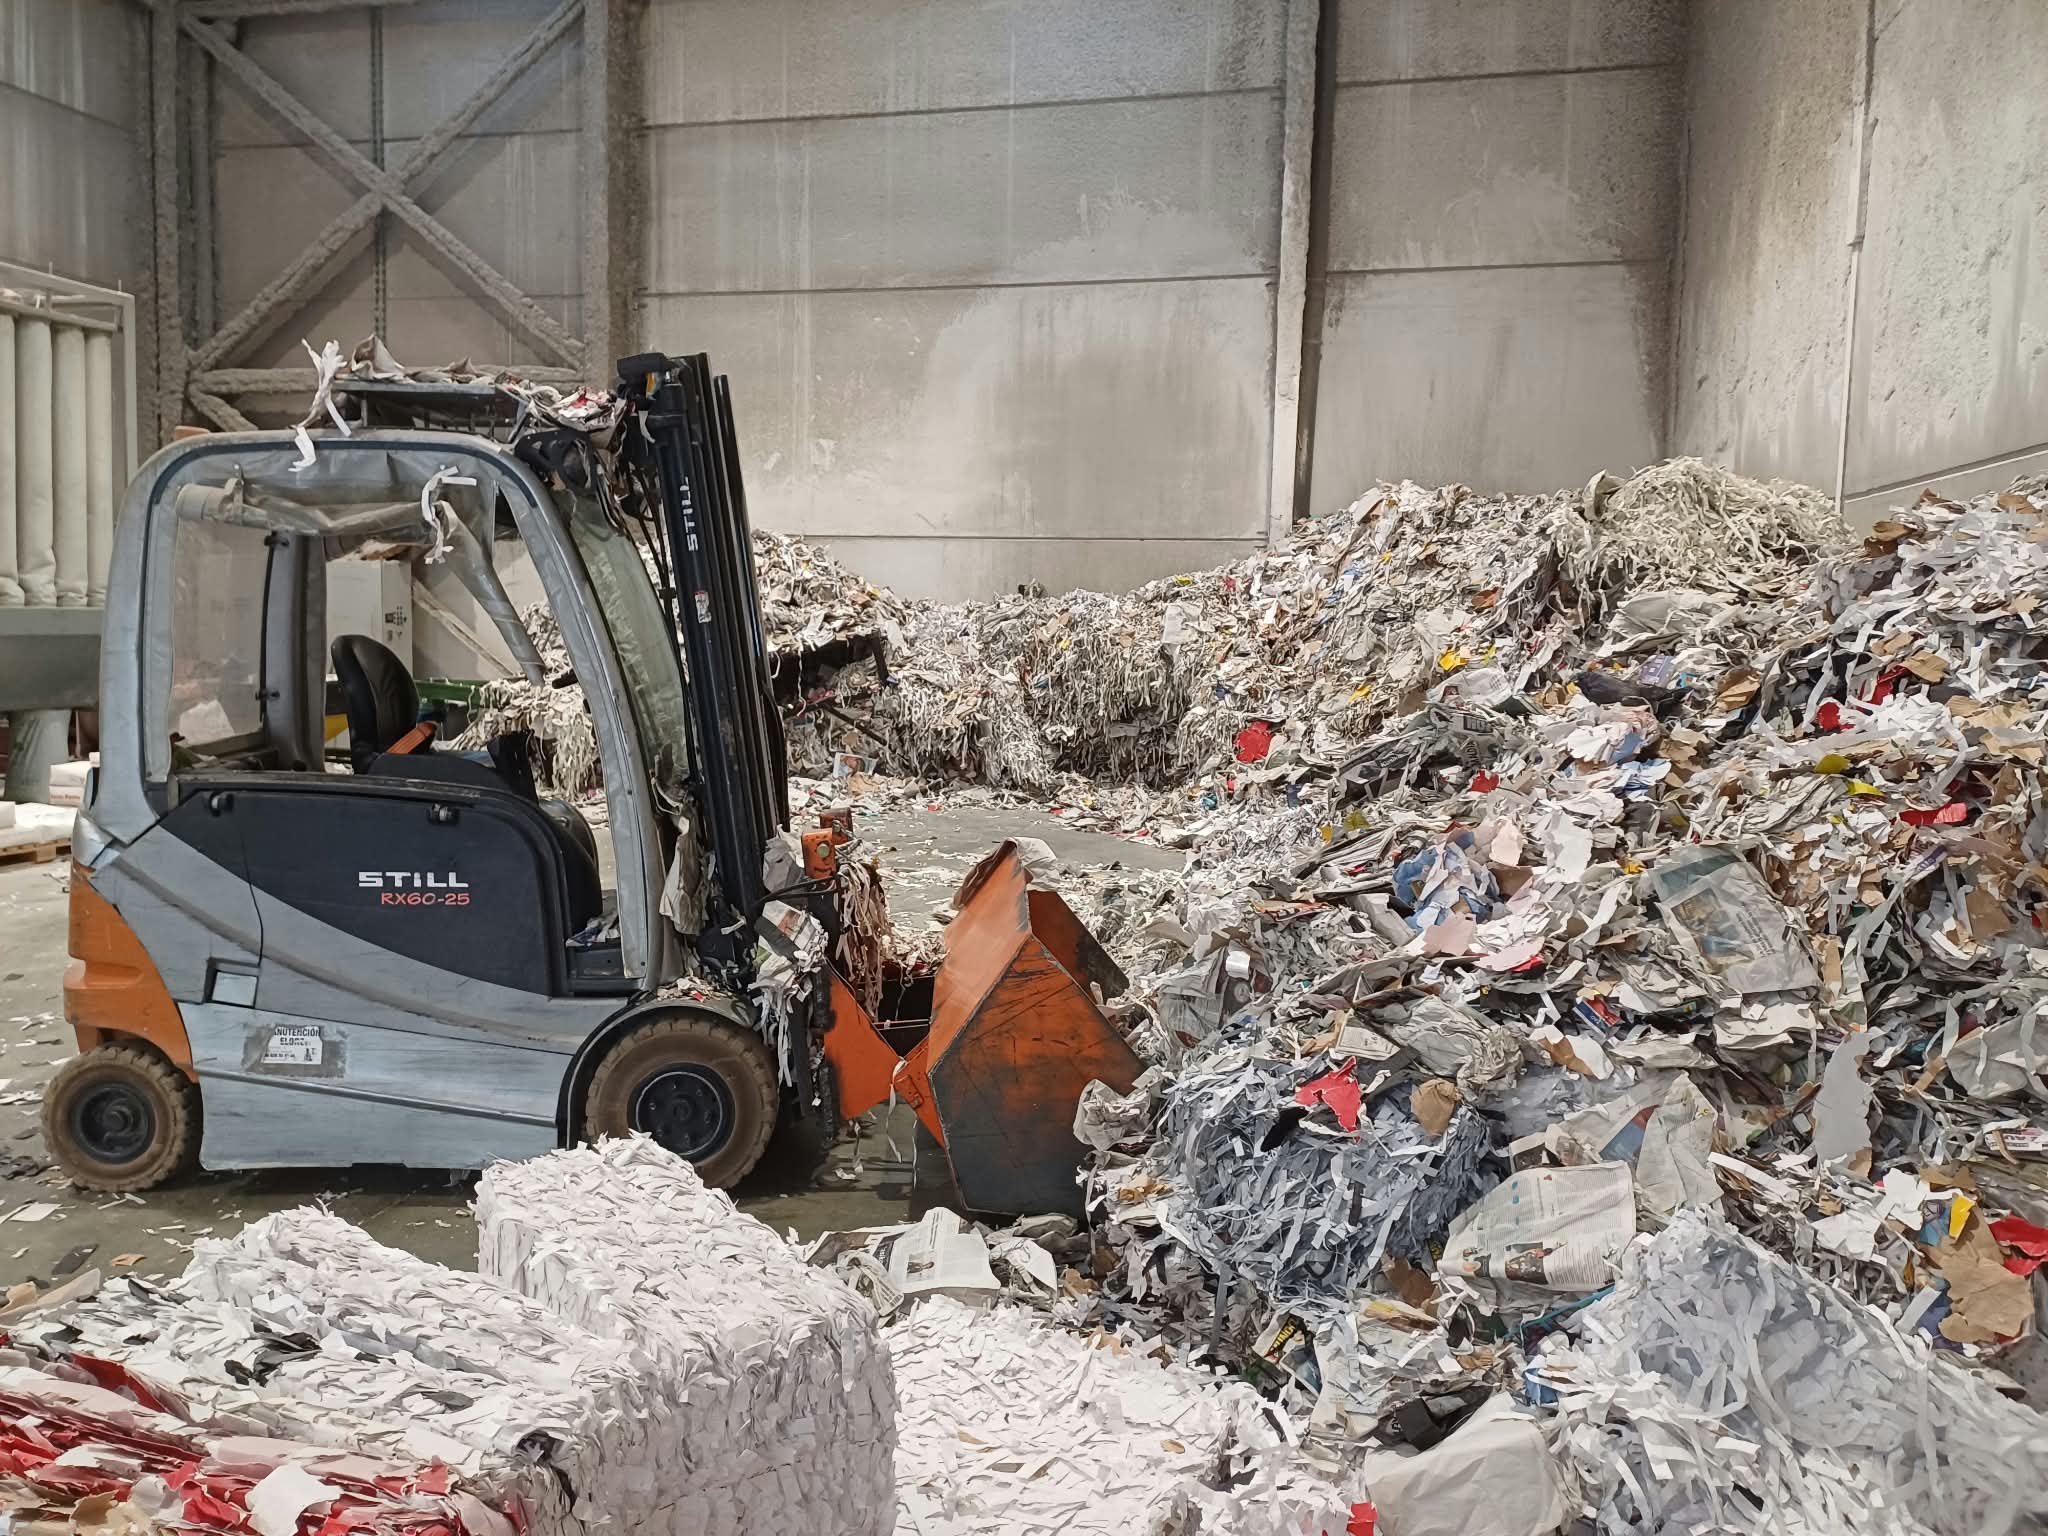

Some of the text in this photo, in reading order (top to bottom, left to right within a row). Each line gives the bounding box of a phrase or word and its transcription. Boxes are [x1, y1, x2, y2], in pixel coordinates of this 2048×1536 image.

[680, 476, 699, 551] STILL
[358, 872, 469, 888] STILL
[381, 893, 471, 905] RX60-25
